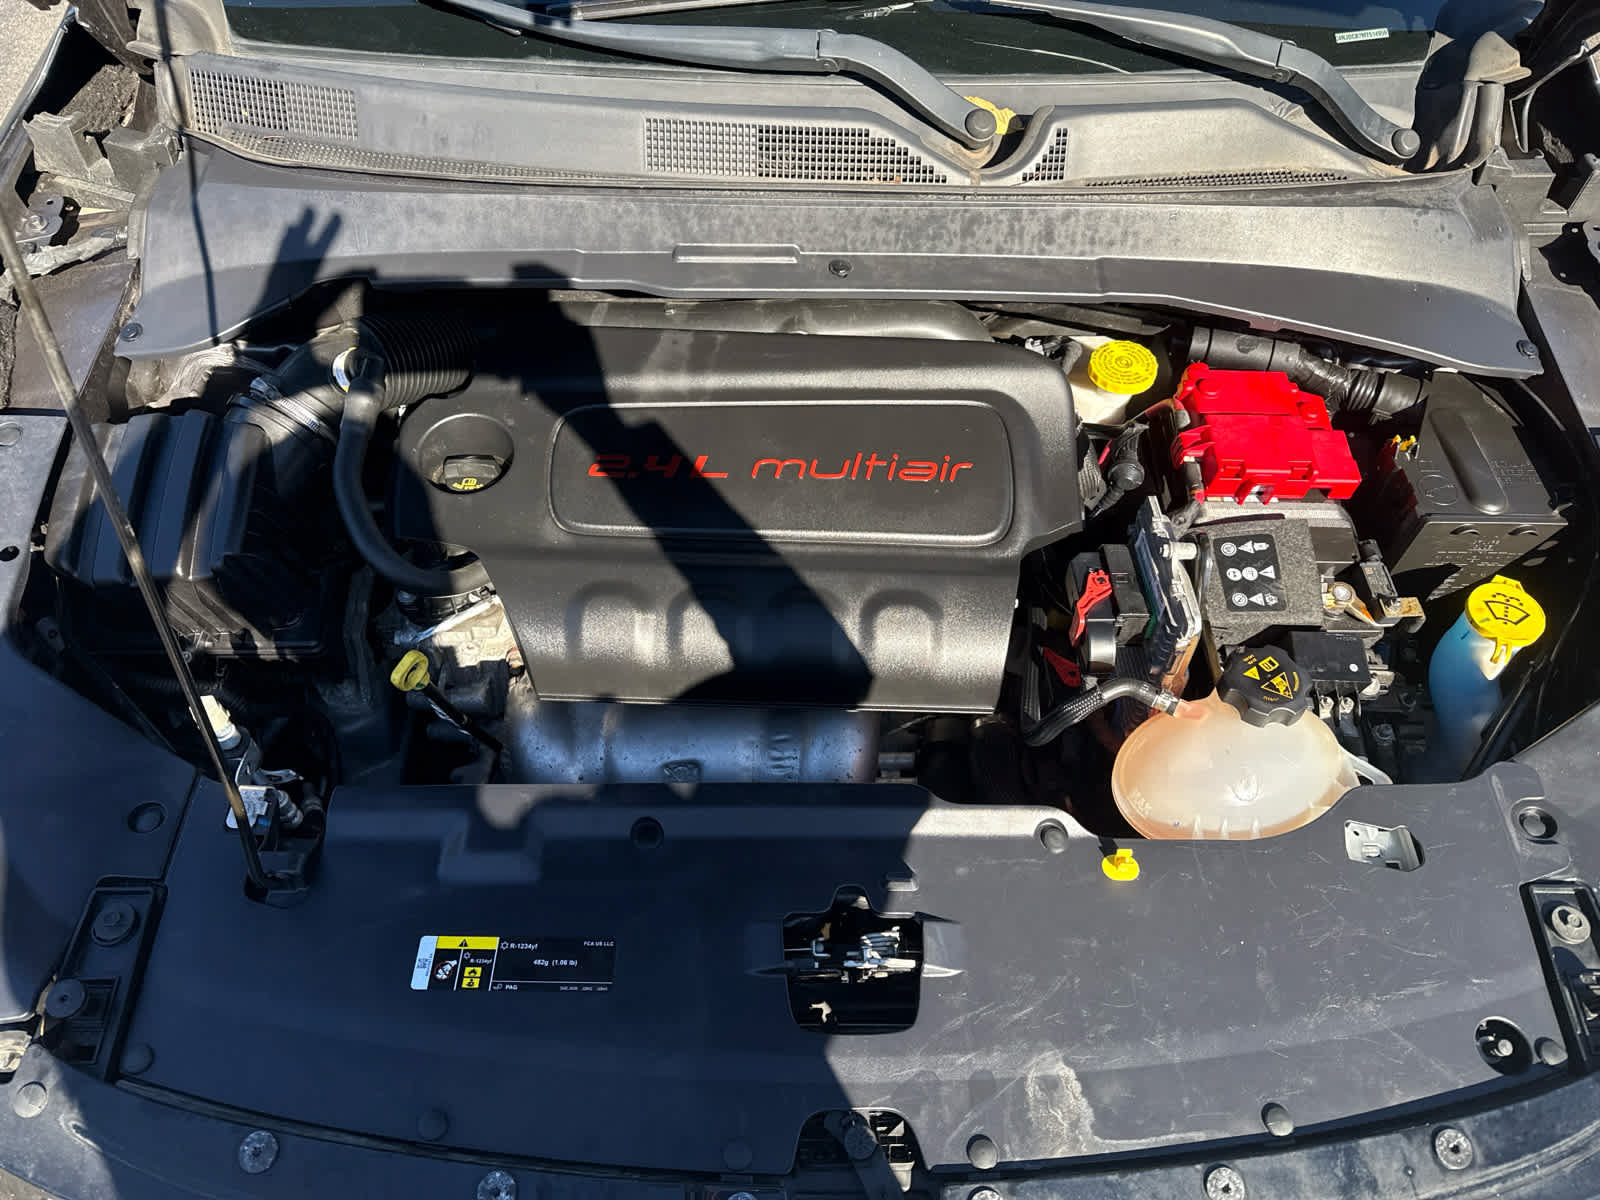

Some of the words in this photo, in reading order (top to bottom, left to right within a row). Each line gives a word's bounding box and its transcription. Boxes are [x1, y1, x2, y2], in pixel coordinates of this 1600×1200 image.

[751, 452, 974, 482] multiair
[509, 943, 538, 951] R-1234yf
[569, 959, 578, 967] lb)
